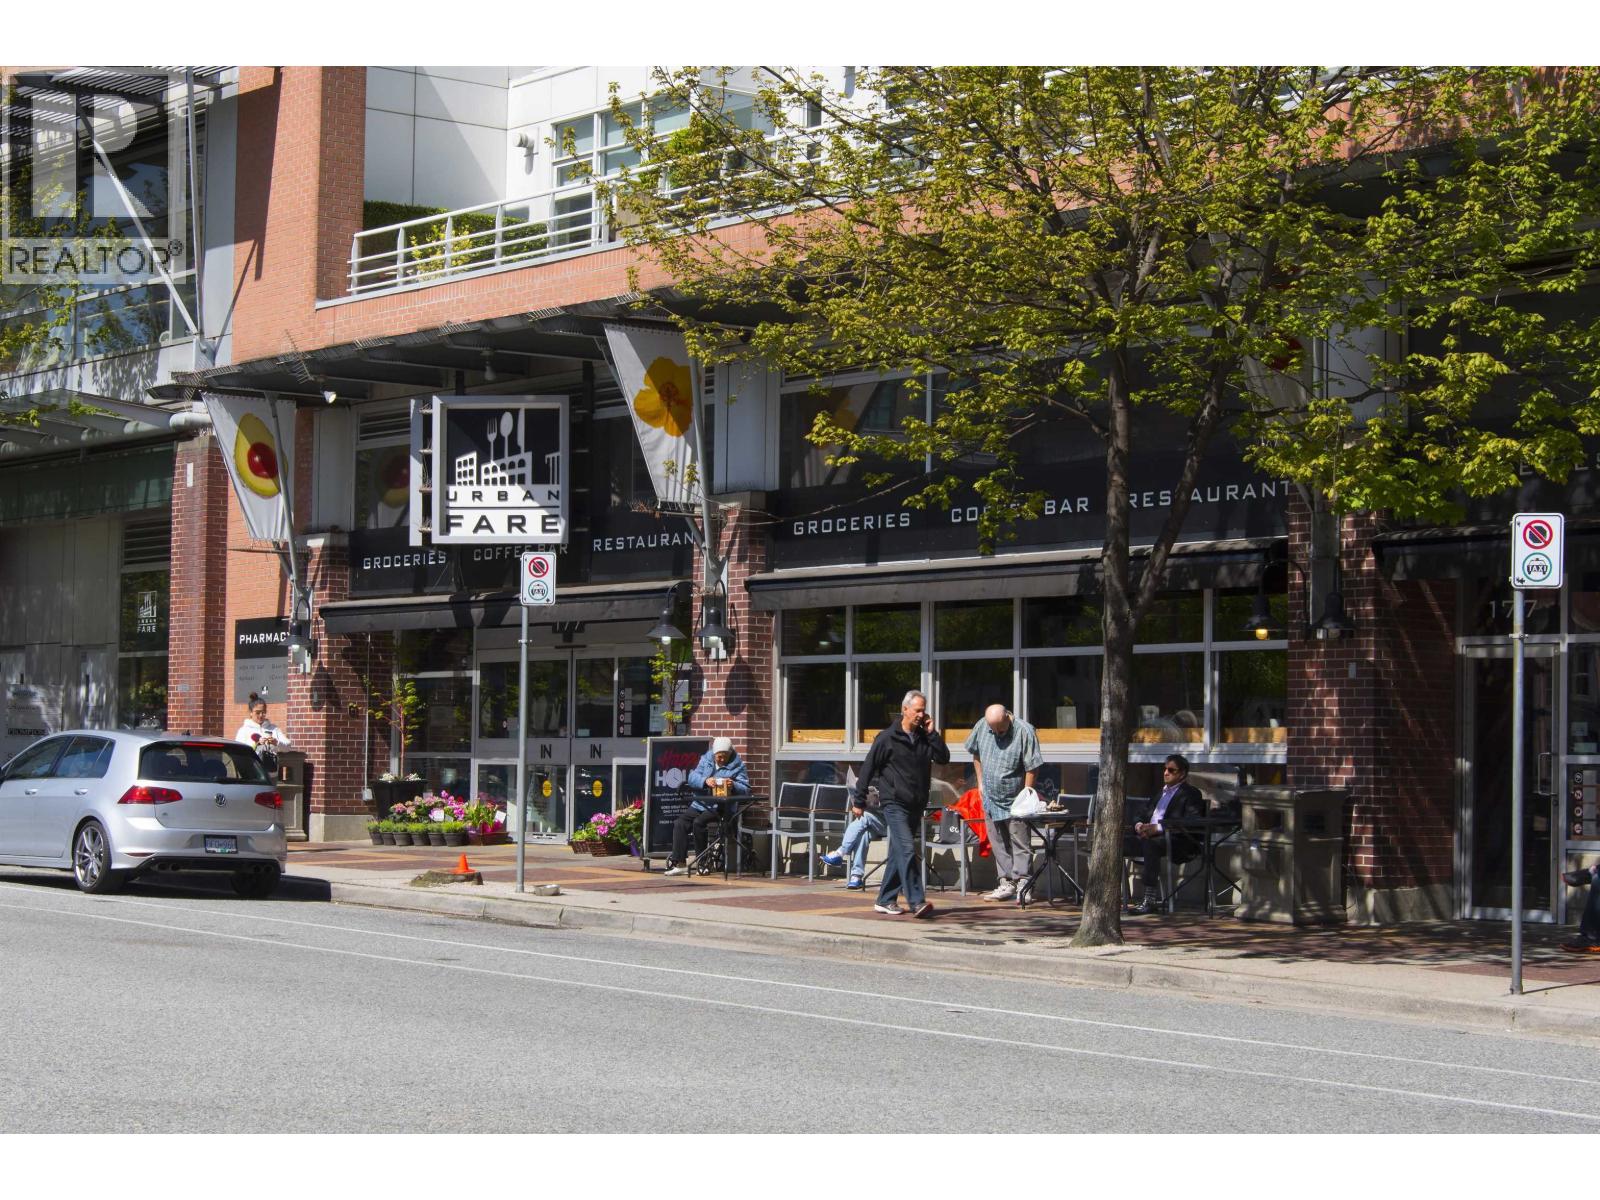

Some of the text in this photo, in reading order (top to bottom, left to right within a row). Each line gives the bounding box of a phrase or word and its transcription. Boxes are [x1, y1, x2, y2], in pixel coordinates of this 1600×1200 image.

[446, 490, 560, 503] URBAN
[793, 511, 911, 536] GROCERIES
[1044, 497, 1089, 515] BAR
[1129, 480, 1290, 508] RESAURANT
[446, 514, 560, 534] FARE
[363, 550, 447, 570] GROCERIES
[593, 531, 695, 552] RESTAURAN
[137, 625, 157, 633] FARE
[540, 743, 552, 759] IN
[590, 743, 602, 759] IN
